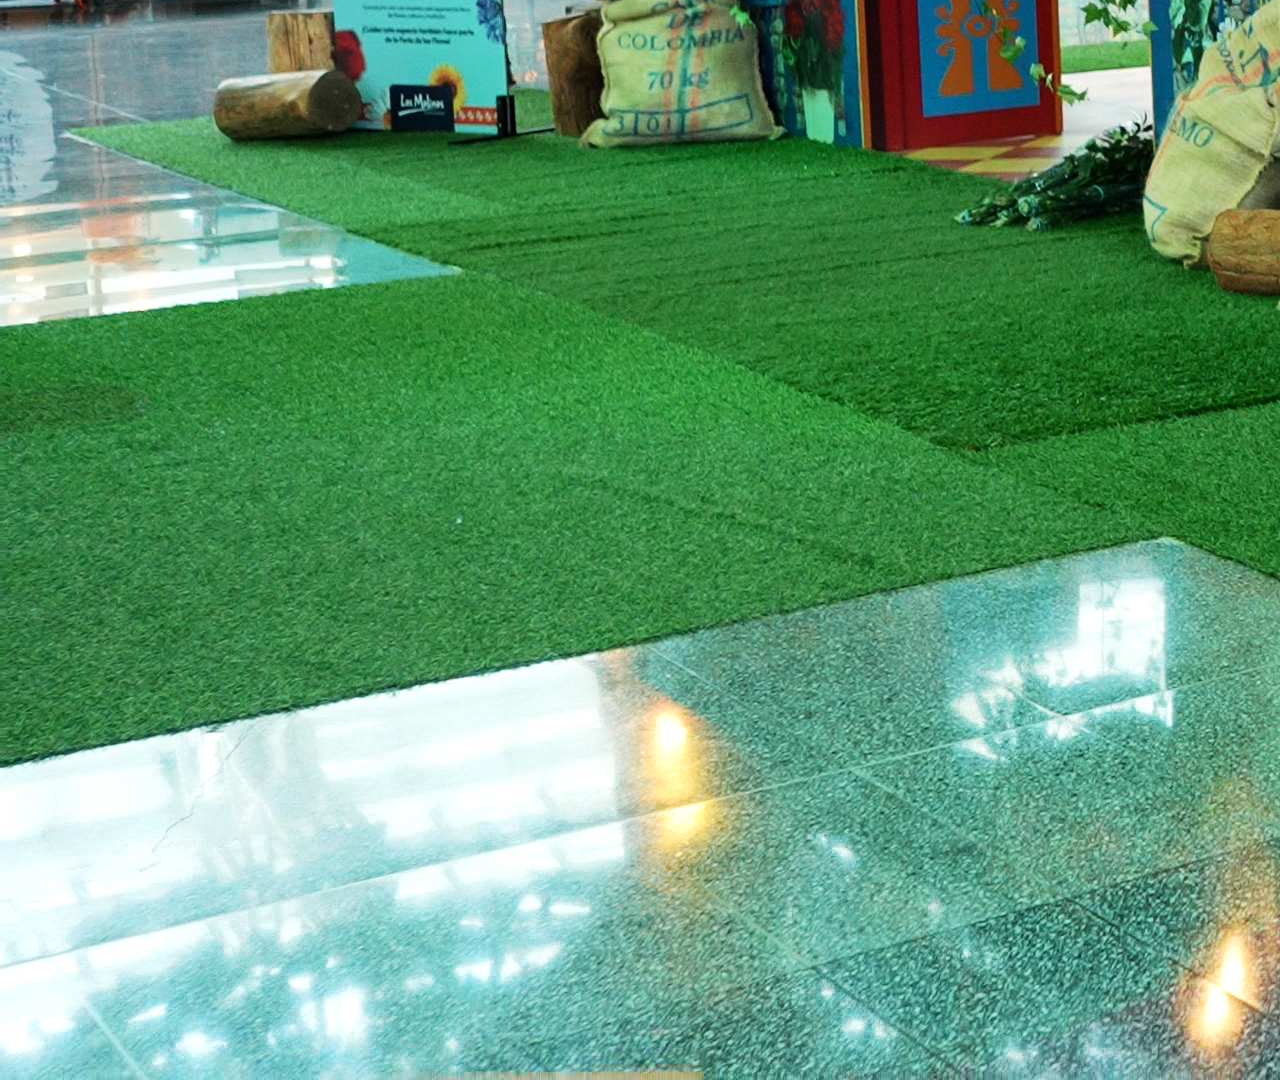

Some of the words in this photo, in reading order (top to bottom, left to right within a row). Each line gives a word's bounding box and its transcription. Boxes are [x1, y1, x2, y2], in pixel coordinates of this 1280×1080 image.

[617, 28, 746, 51] COLOMBIA
[648, 70, 673, 91] 70
[684, 69, 710, 89] kg
[400, 93, 413, 108] Los
[413, 92, 445, 110] Molinos
